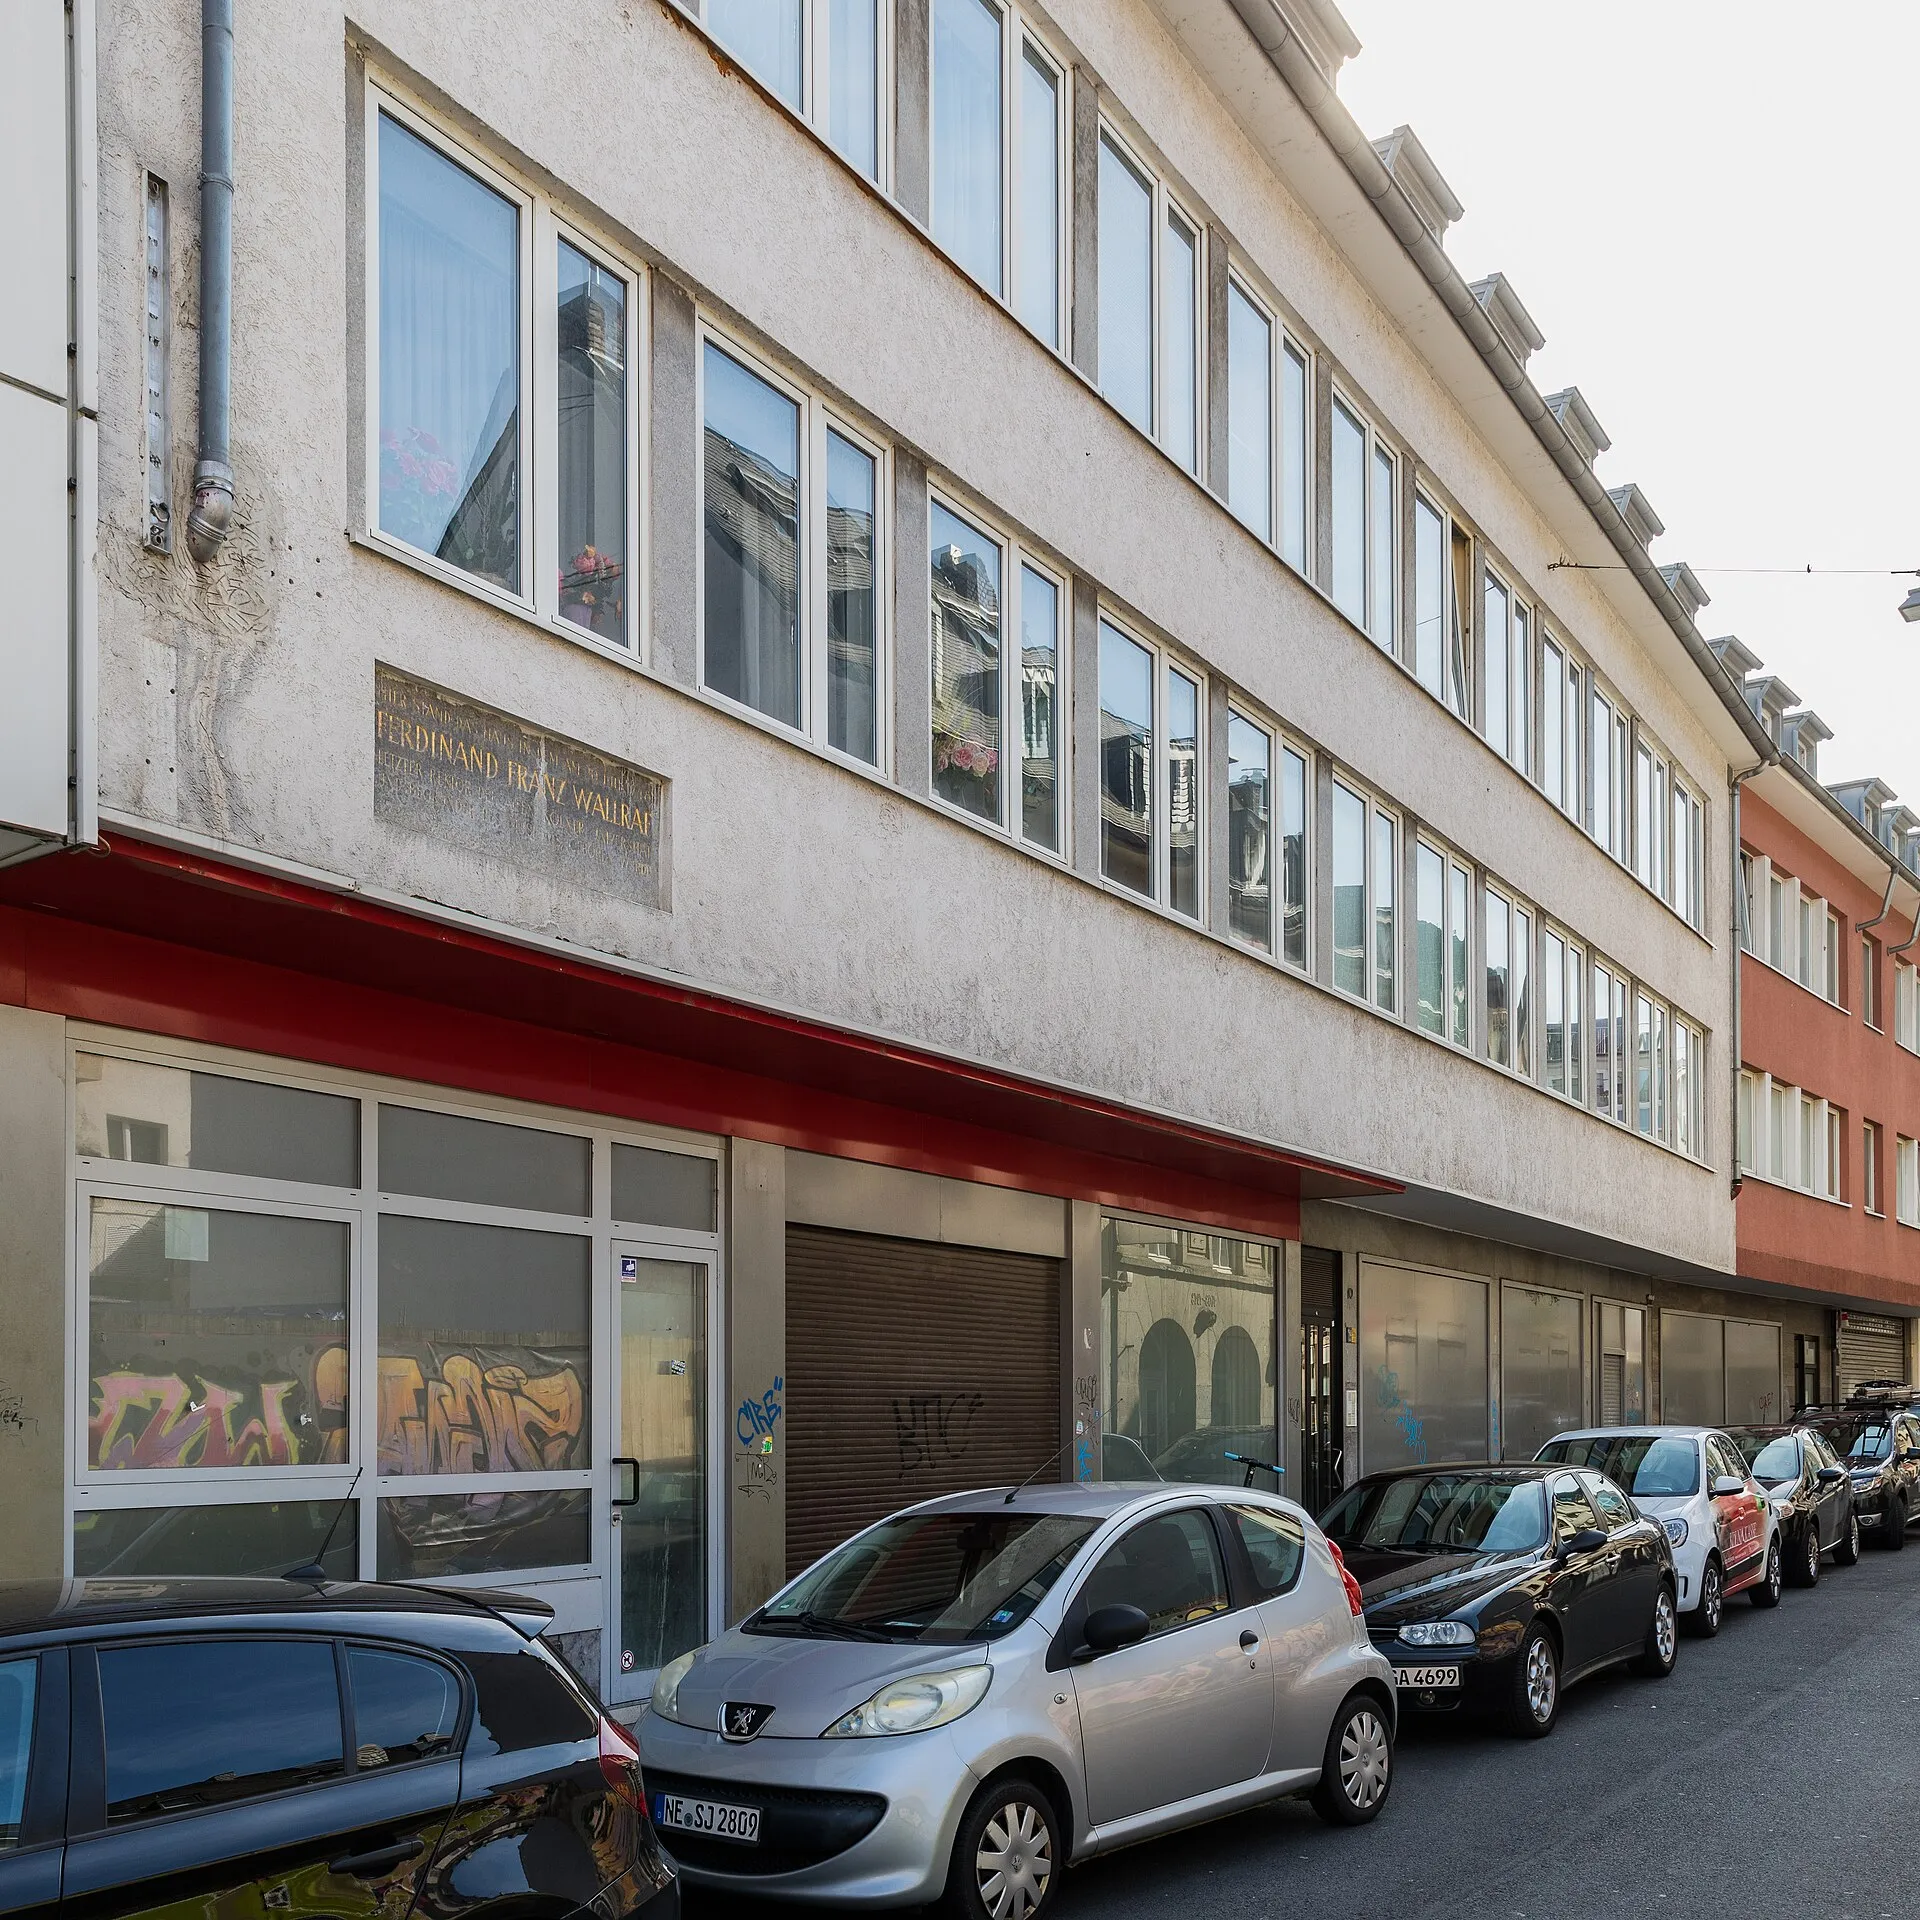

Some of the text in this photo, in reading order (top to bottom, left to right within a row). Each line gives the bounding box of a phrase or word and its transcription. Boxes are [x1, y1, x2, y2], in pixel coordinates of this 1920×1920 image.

[377, 709, 498, 780] FERDINAND
[507, 759, 566, 806] FRANZ
[377, 748, 423, 779] LETZTER
[1414, 1668, 1457, 1685] 4699
[665, 1798, 684, 1825] NE
[694, 1803, 715, 1831] SJ
[717, 1807, 758, 1838] 2809
